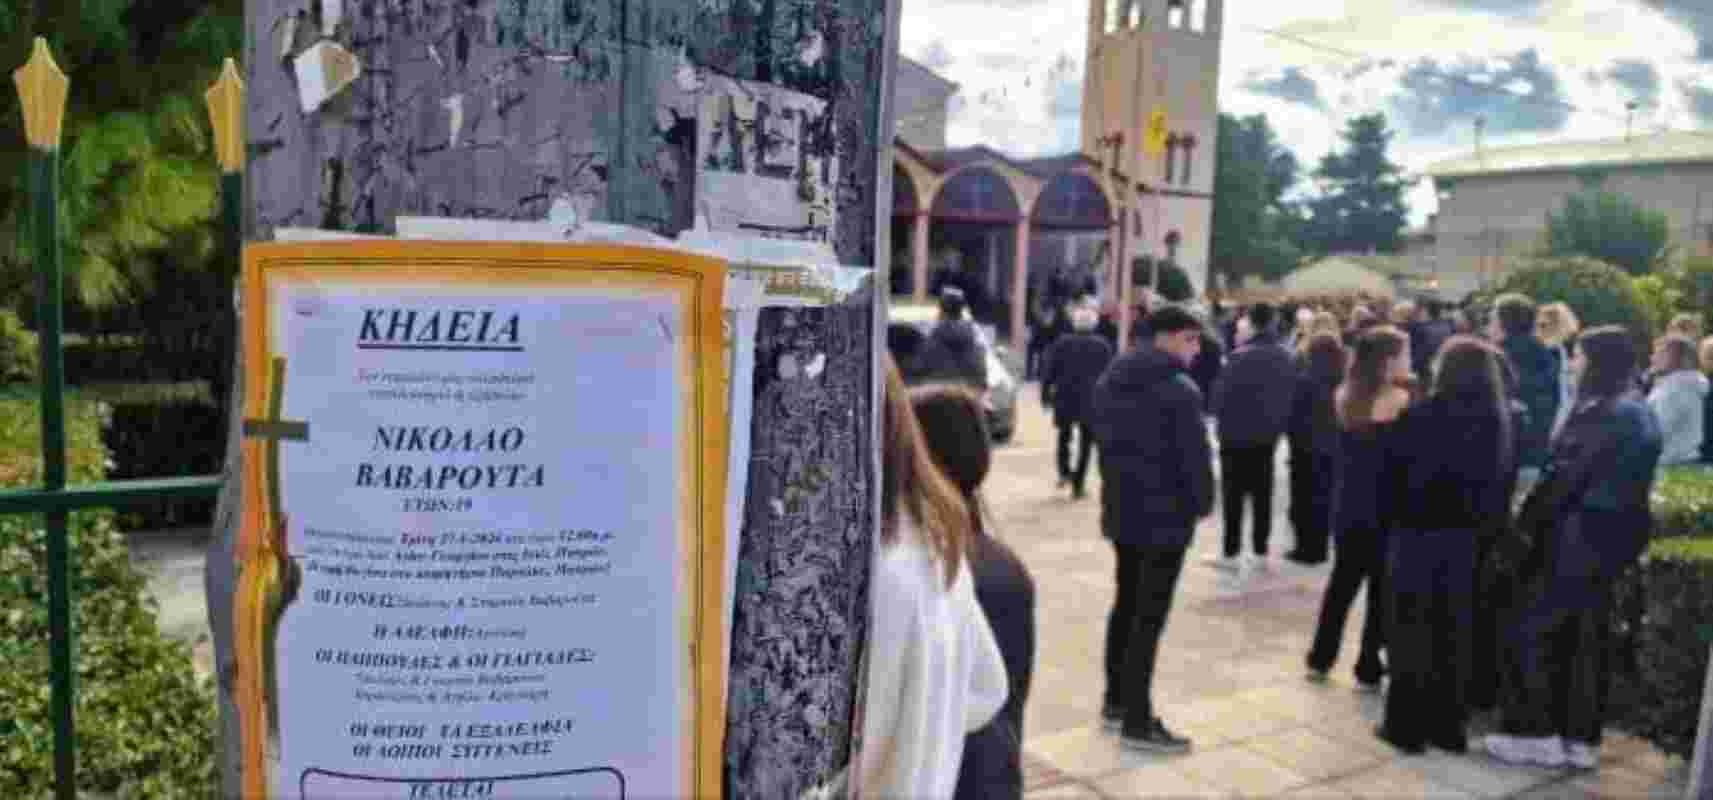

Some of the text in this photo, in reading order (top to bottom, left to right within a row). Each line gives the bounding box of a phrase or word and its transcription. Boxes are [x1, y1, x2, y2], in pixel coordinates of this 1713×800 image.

[359, 308, 521, 344] ΚΗΔΕΙΑ
[374, 425, 526, 452] ΝΙΚΟΛΑΟ
[355, 462, 545, 490] ΒΑΒΑΡΟΥΤΑ
